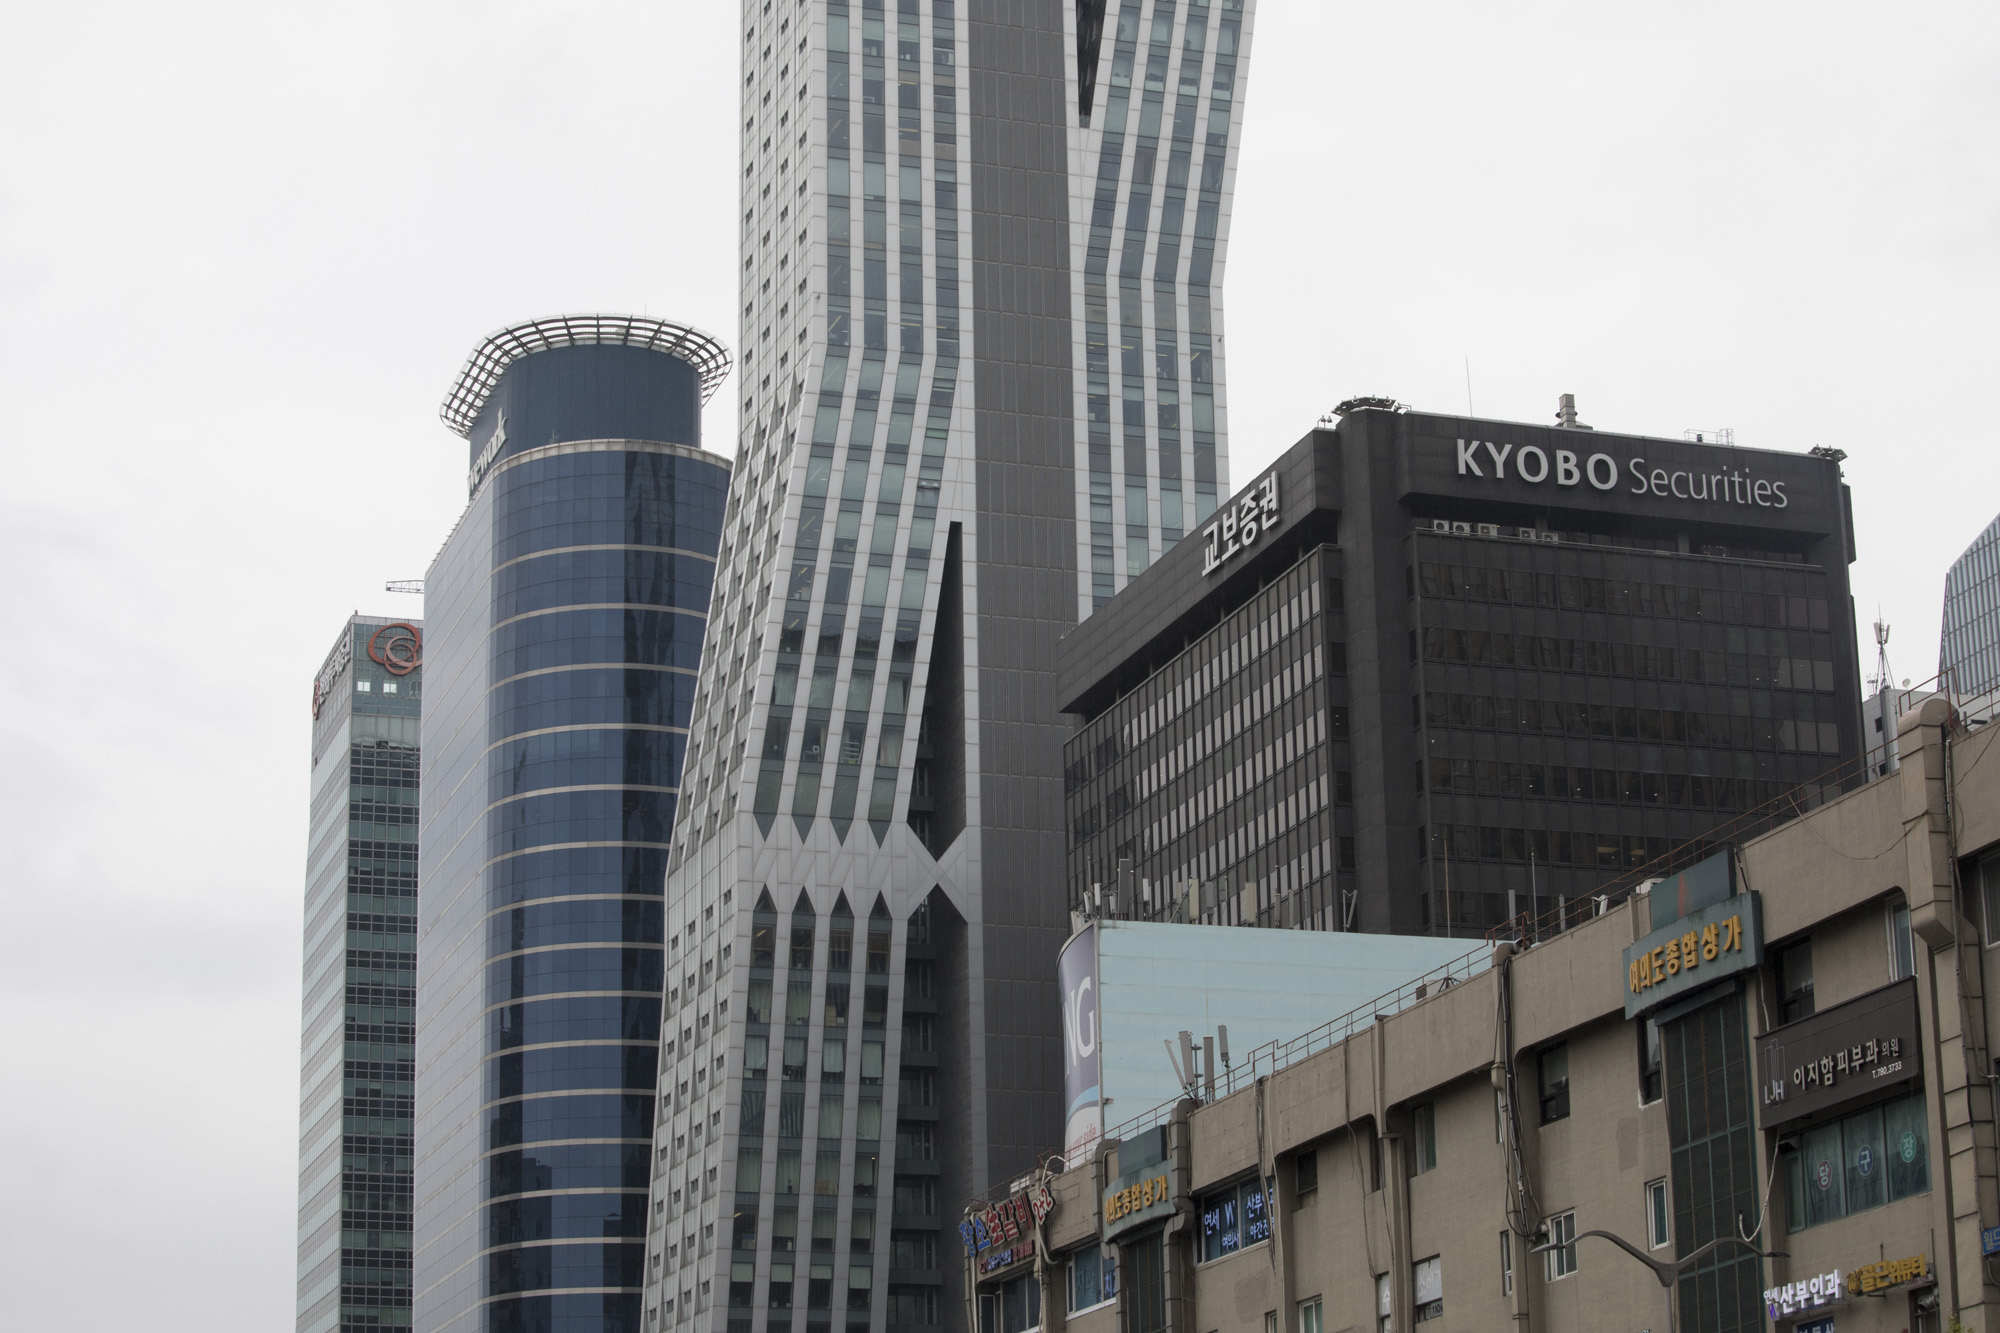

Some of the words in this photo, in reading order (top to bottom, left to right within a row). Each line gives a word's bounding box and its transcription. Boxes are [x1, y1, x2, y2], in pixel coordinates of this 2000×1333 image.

[1456, 438, 1618, 491] KYOBO
[1629, 457, 1789, 508] Securities
[1202, 470, 1279, 577] 교보증권
[1629, 914, 1743, 993] 여의도종합상가
[1793, 1038, 1879, 1090] 이지함피부과
[1871, 1060, 1902, 1079] T.780.3733
[1764, 1079, 1785, 1105] LJH
[1779, 1268, 1841, 1314] 산부인과
